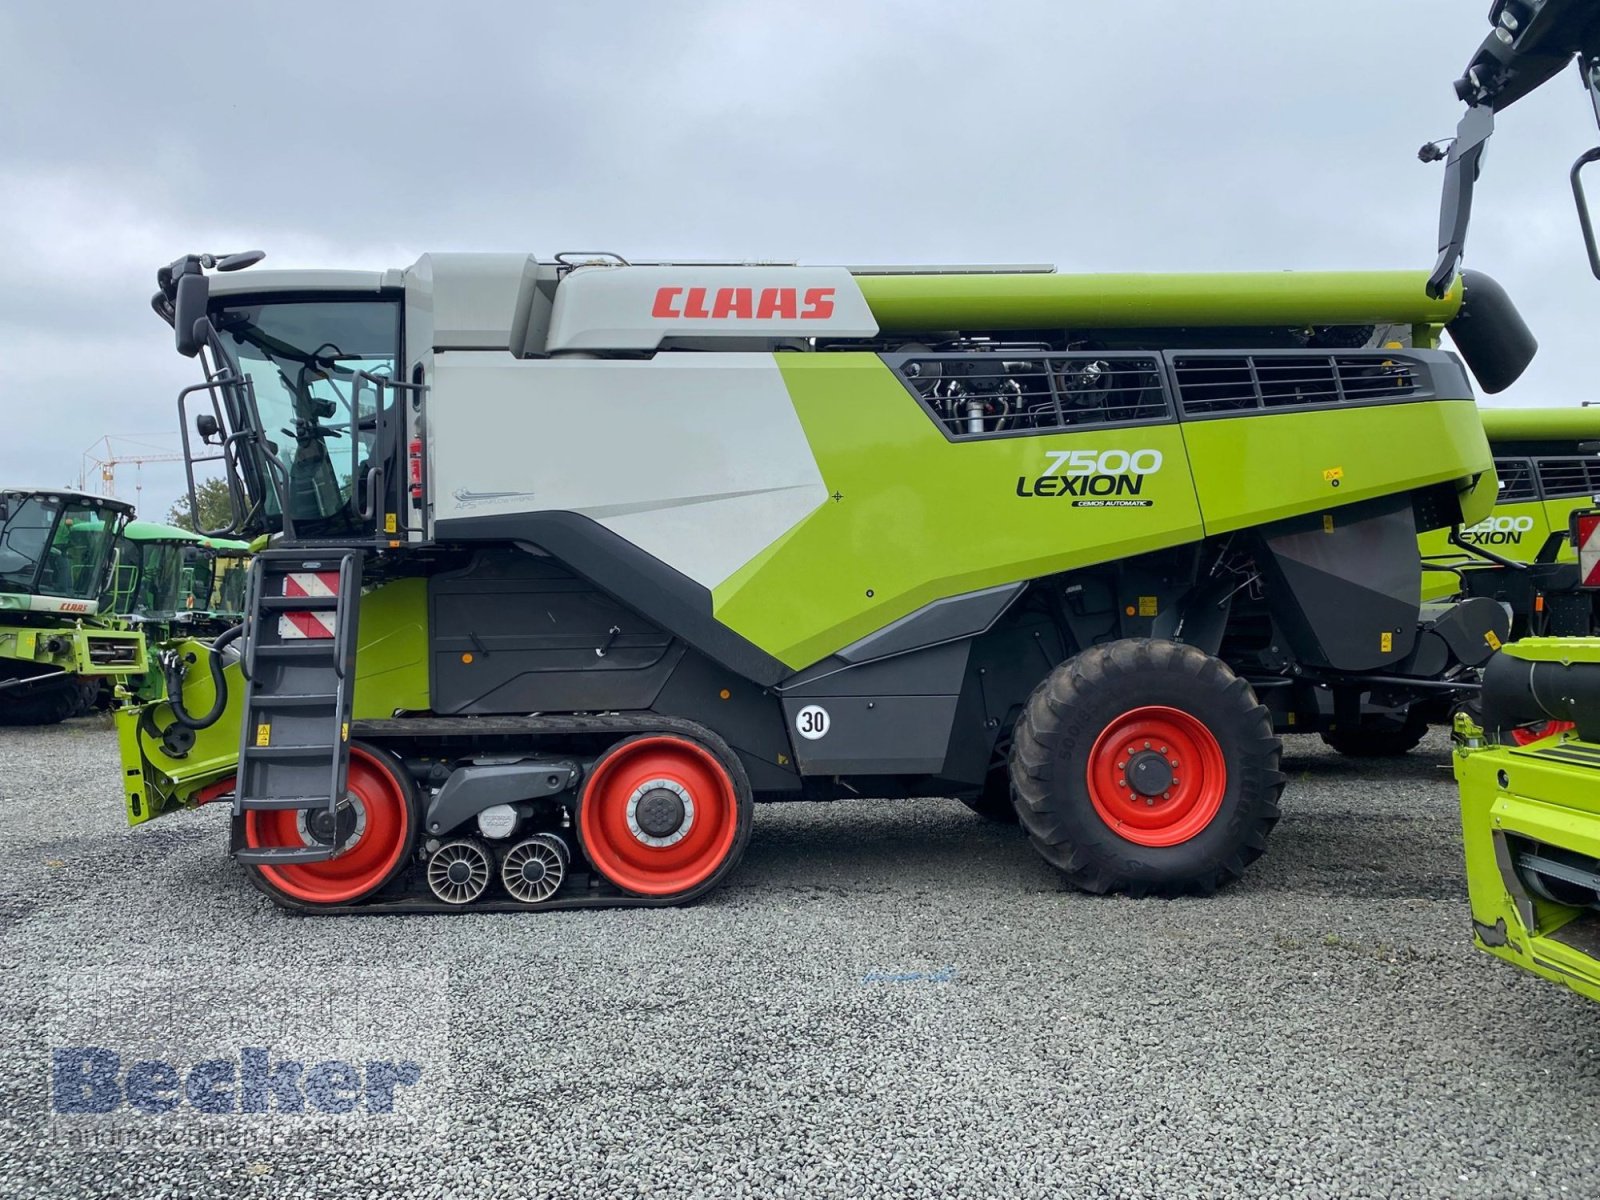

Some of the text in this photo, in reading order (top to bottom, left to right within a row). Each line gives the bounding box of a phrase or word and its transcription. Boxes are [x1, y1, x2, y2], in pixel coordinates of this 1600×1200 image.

[651, 287, 836, 320] CLAAS
[1042, 448, 1163, 477] 7500
[1016, 474, 1144, 497] LEXION
[60, 602, 88, 612] CLAAS
[802, 711, 824, 733] 30
